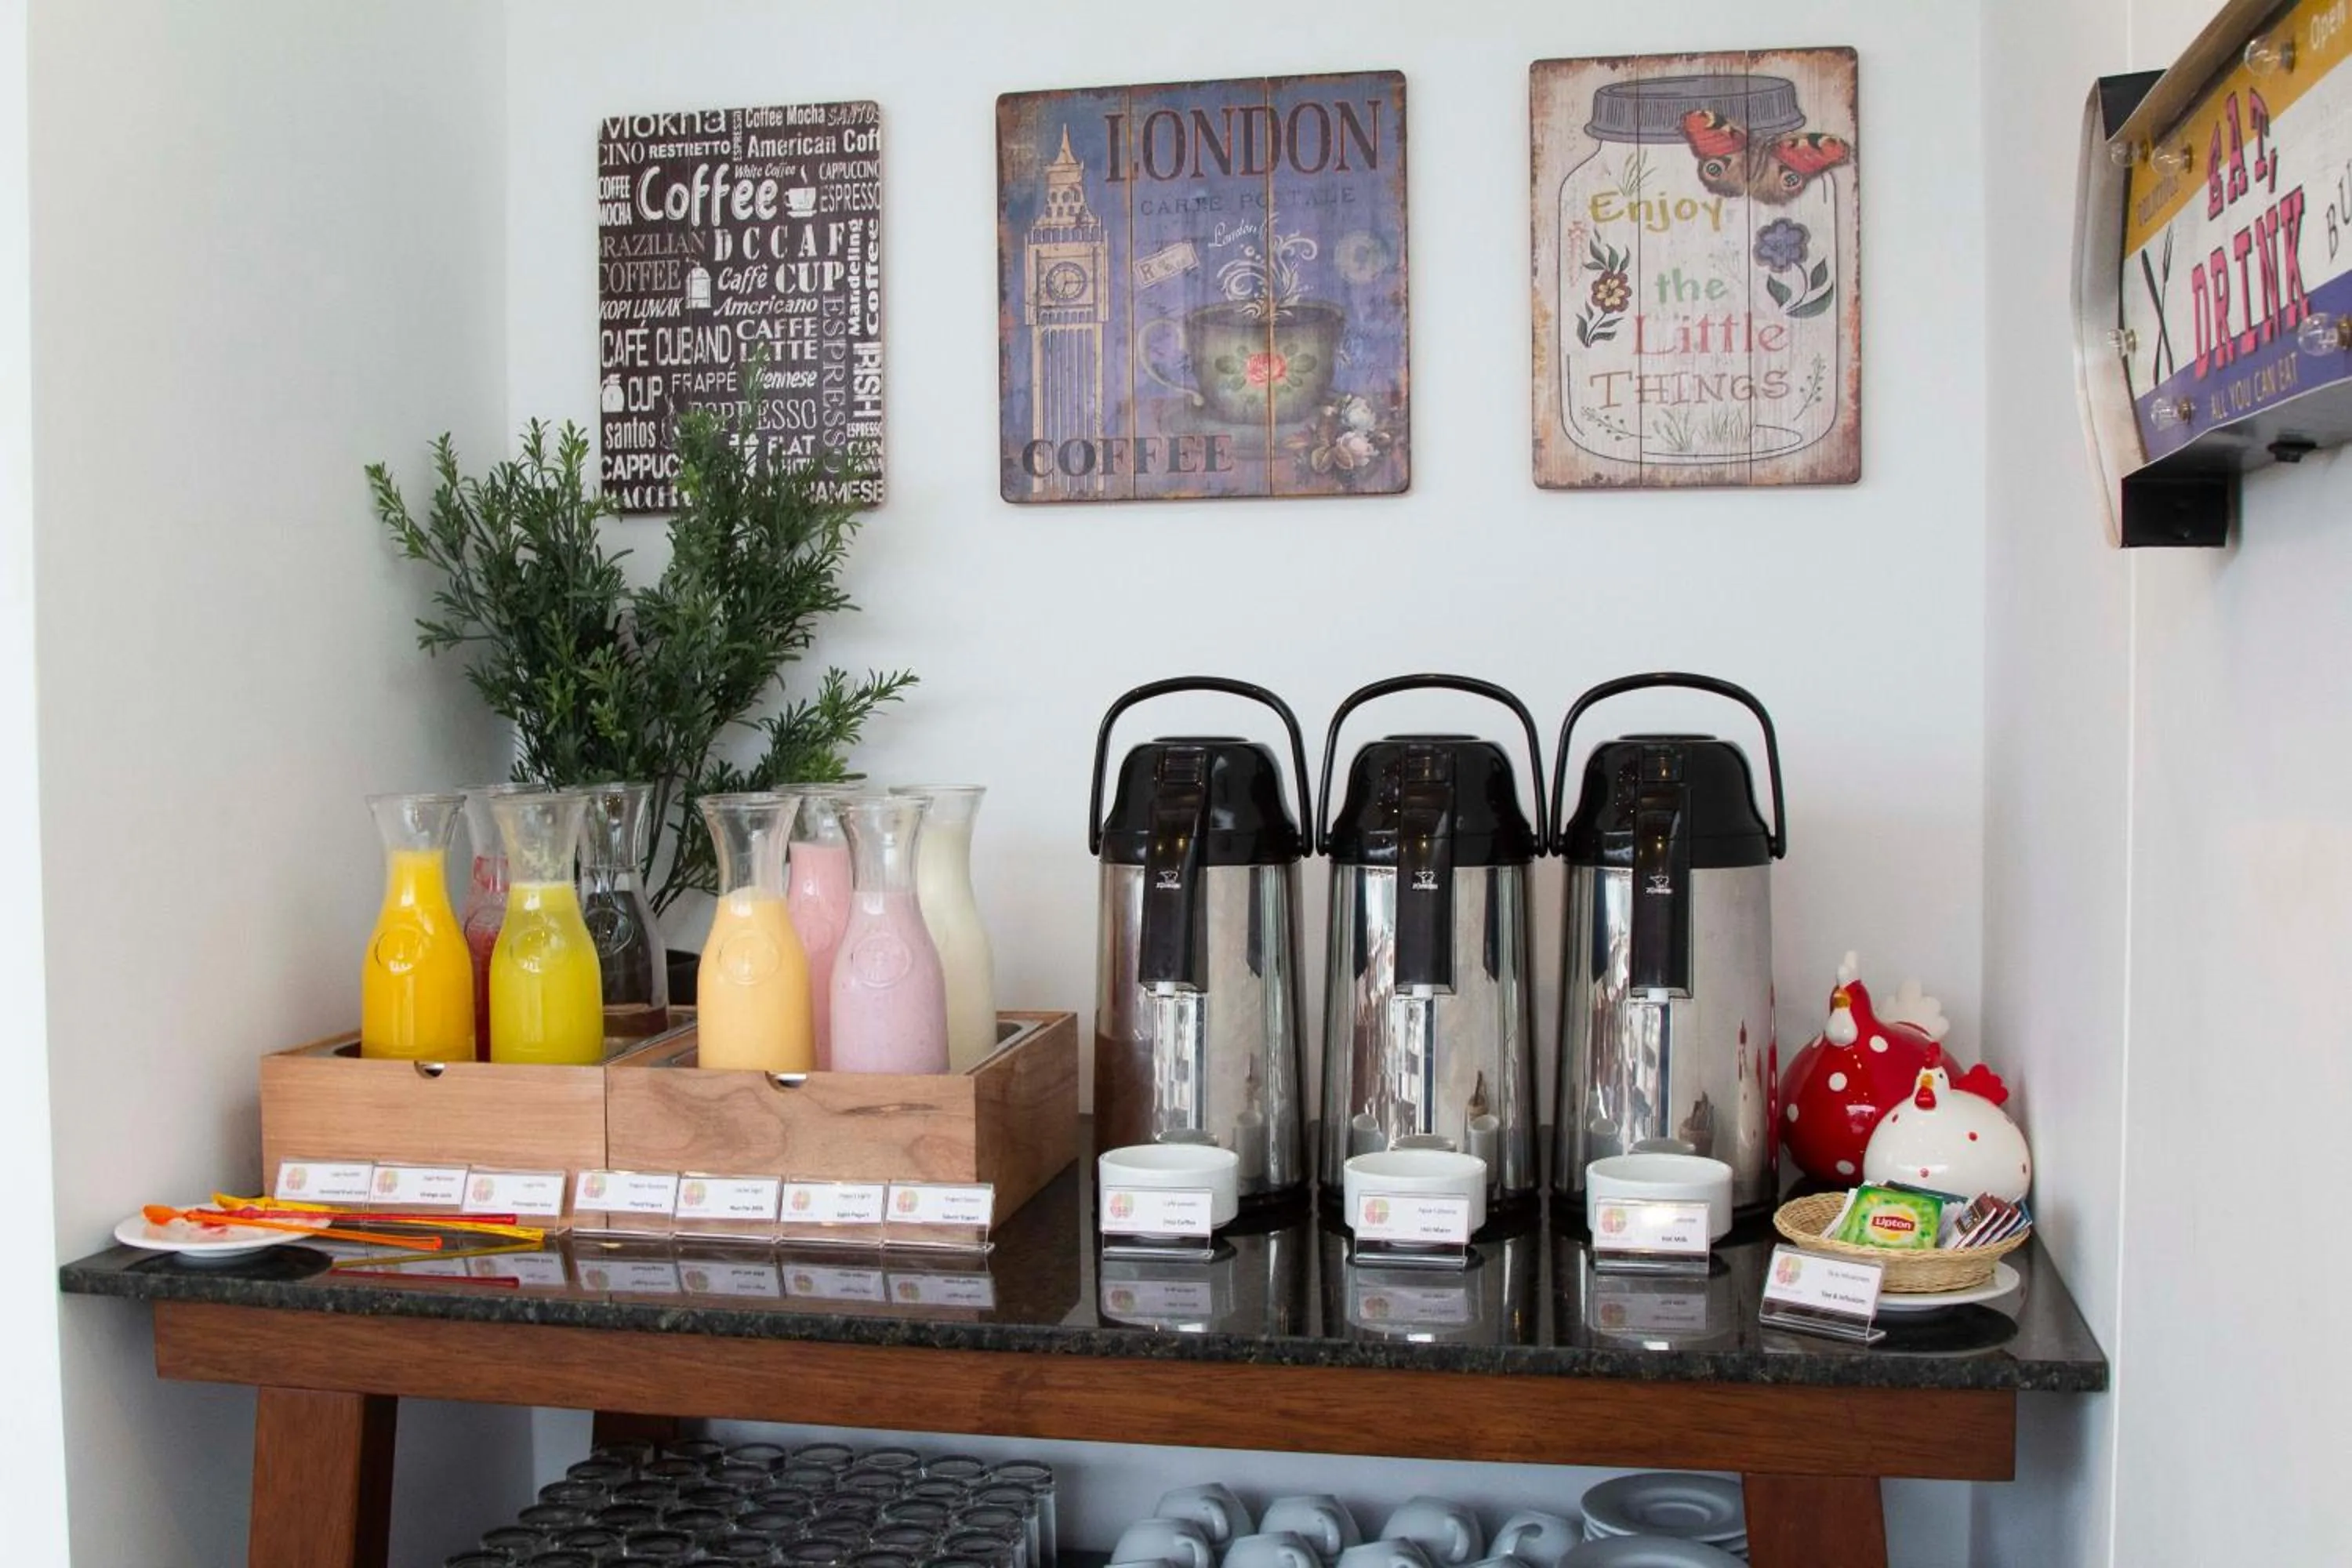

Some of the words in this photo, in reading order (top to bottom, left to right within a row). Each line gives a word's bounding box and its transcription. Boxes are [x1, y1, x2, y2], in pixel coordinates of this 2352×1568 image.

[786, 103, 826, 125] Mocha
[747, 132, 837, 158] American
[1104, 100, 1382, 183] LONDON
[599, 175, 631, 200] COFFEE
[636, 162, 778, 227] Coffee
[598, 202, 632, 227] MOCHA
[1589, 188, 1724, 234] Enjoy
[775, 260, 844, 294] CUP
[866, 218, 880, 336] Coffee
[1656, 267, 1726, 305] the
[2191, 185, 2309, 381] DRINK
[600, 299, 632, 321] KOPI
[633, 296, 684, 319] LUWAK
[736, 316, 818, 340] CAFFE
[1632, 314, 1790, 356] Little
[628, 376, 663, 412] CUP
[852, 342, 881, 418] IRISH
[605, 416, 655, 450] santos
[1022, 434, 1233, 477] COFFEE
[1875, 1217, 1911, 1231] Lipton
